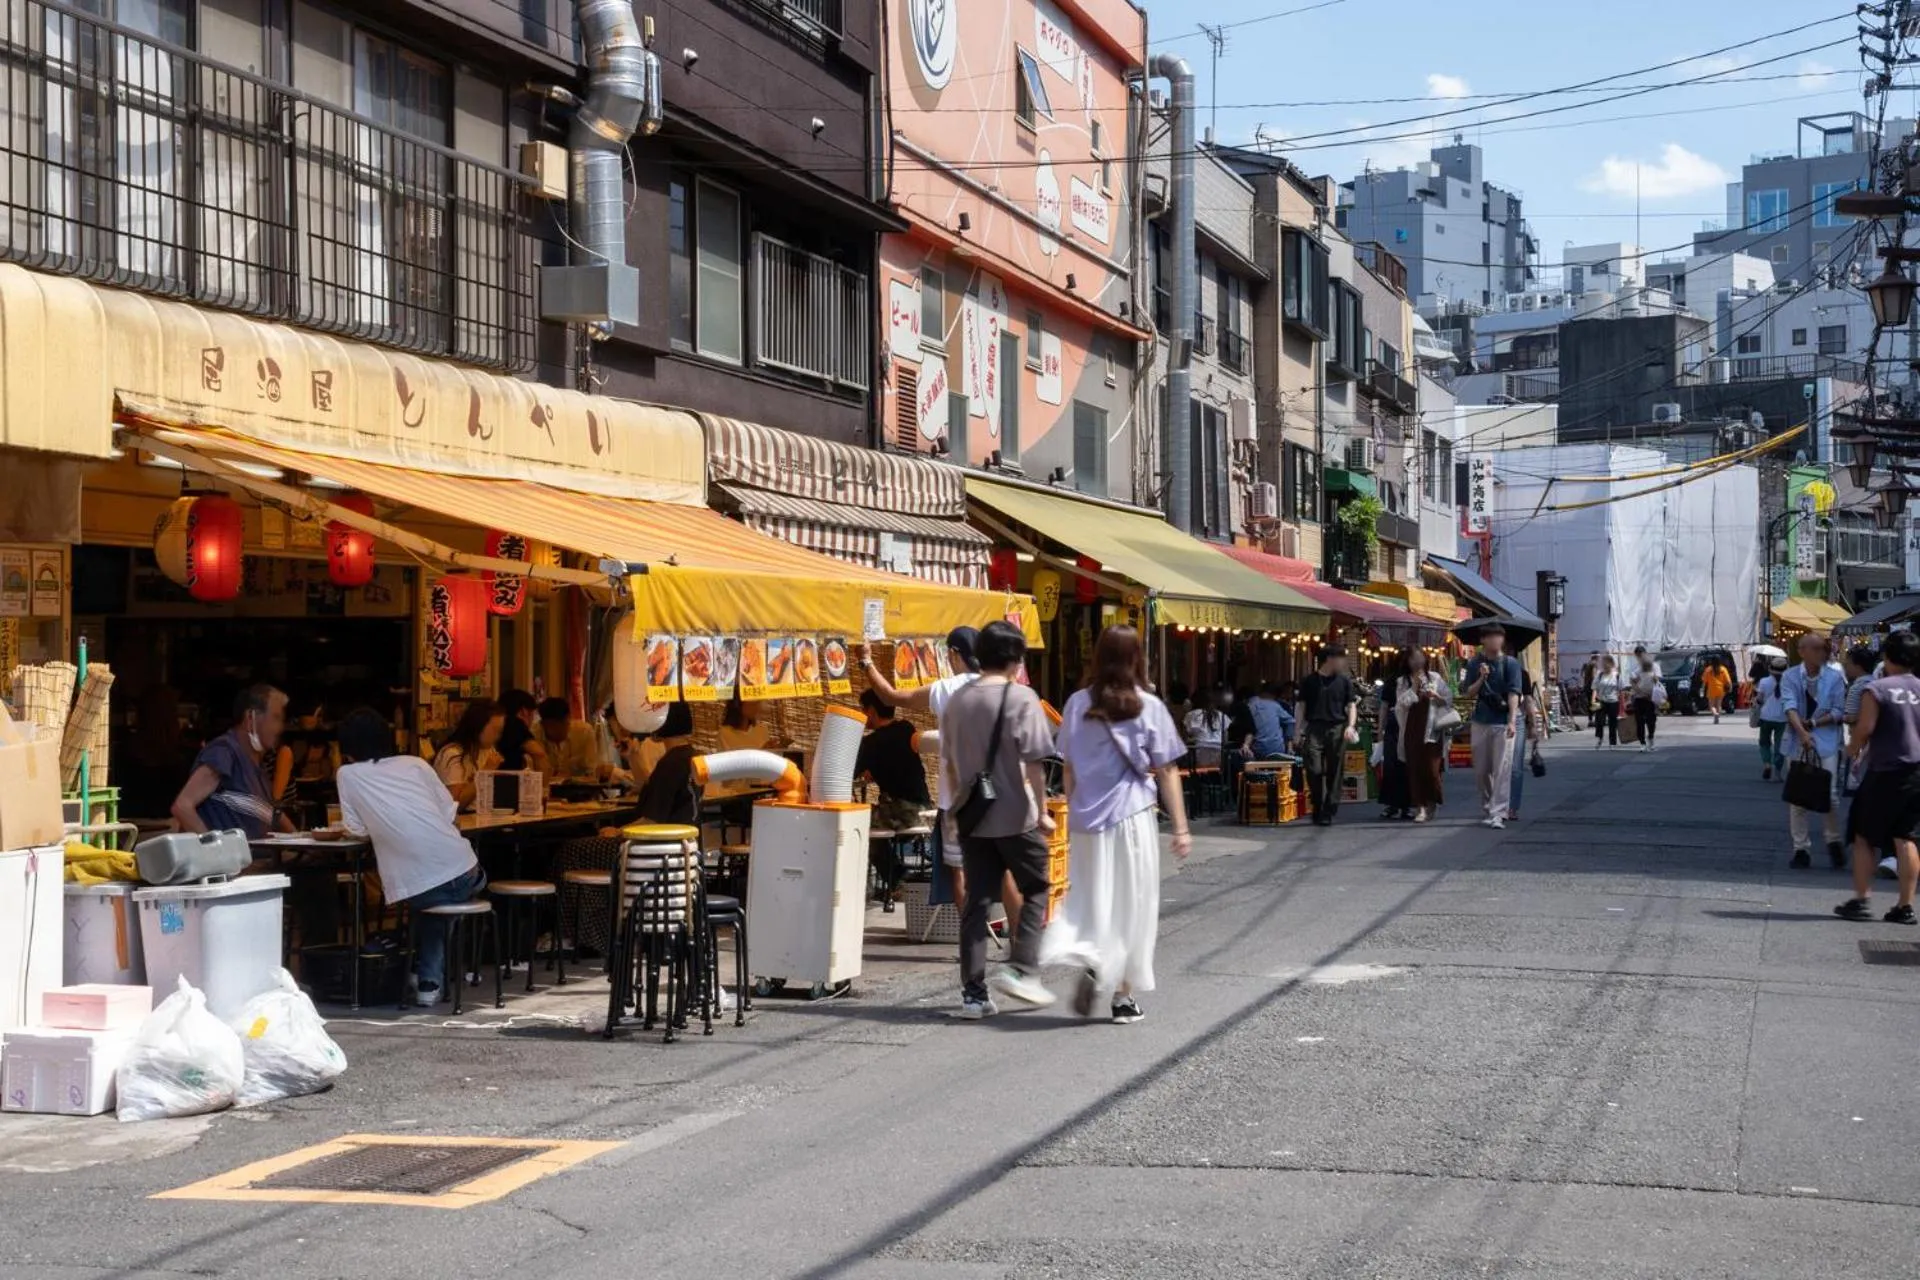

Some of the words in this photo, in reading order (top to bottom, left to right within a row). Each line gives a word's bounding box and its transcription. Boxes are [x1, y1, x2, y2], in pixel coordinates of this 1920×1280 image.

[892, 300, 919, 335] ビール
[202, 347, 333, 412] 居酒屋
[394, 366, 611, 456] とんぺい
[1472, 459, 1485, 512] 山加商店
